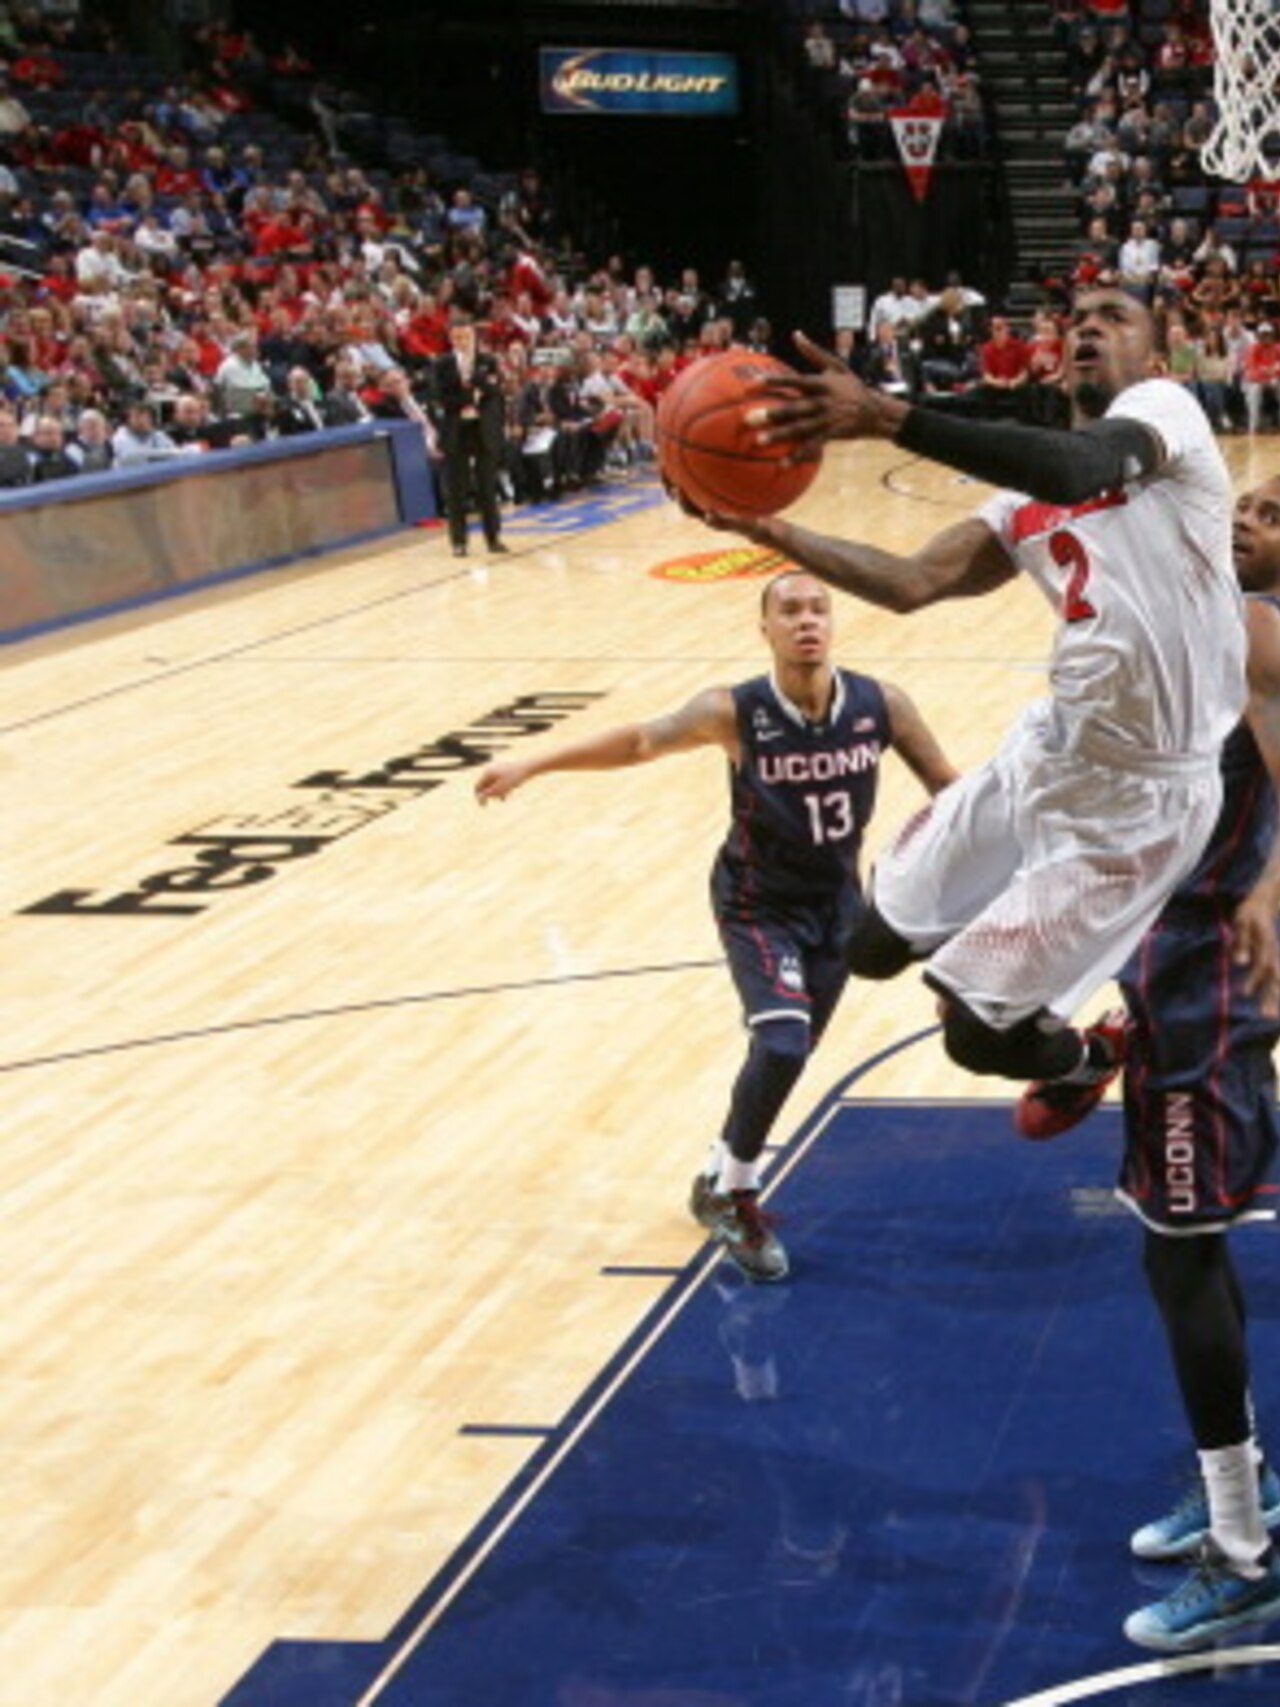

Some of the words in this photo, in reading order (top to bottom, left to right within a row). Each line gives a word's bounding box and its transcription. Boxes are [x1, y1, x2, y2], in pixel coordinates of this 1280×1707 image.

[635, 71, 728, 93] LIGHT
[1048, 530, 1097, 623] 2
[757, 741, 881, 786] UCONN
[804, 790, 854, 846] 13
[1165, 1092, 1197, 1213] UCONN
